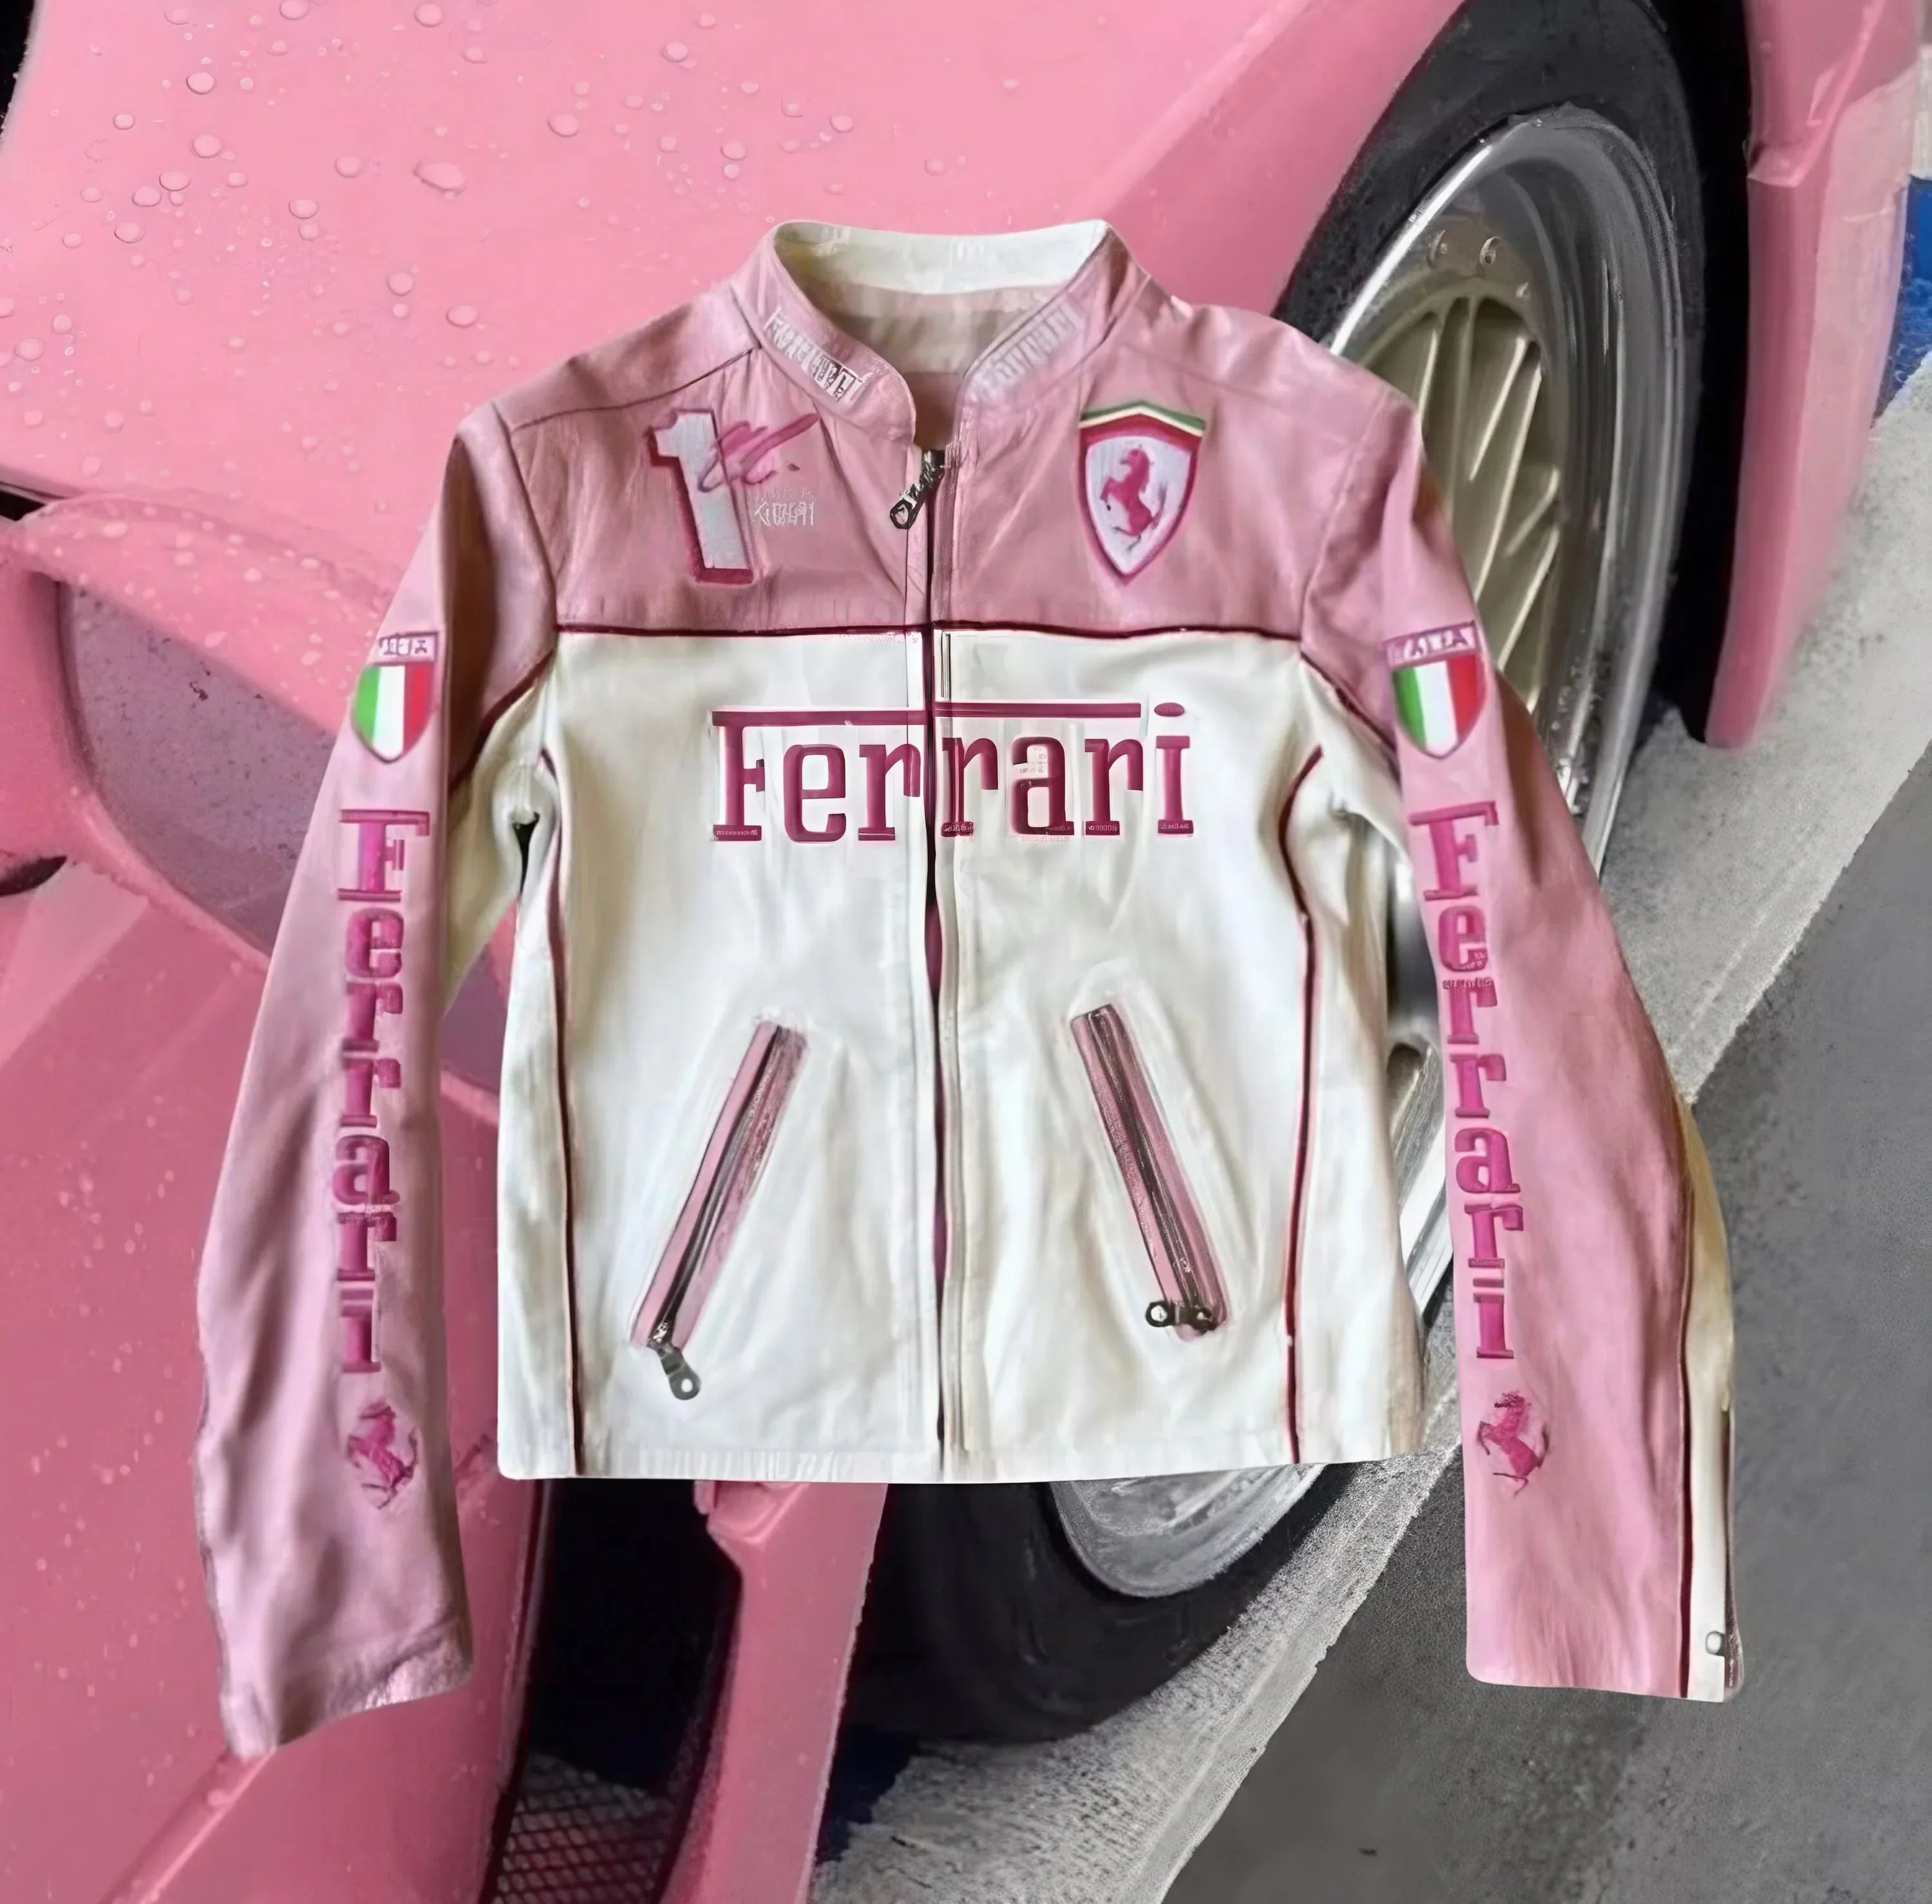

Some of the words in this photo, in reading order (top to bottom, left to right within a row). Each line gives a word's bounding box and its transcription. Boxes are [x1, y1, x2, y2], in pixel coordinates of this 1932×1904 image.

[646, 408, 755, 584] 1
[712, 701, 1195, 842] Ferrari
[336, 808, 430, 1373] Ferrari
[1408, 800, 1523, 1360] Ferrari
